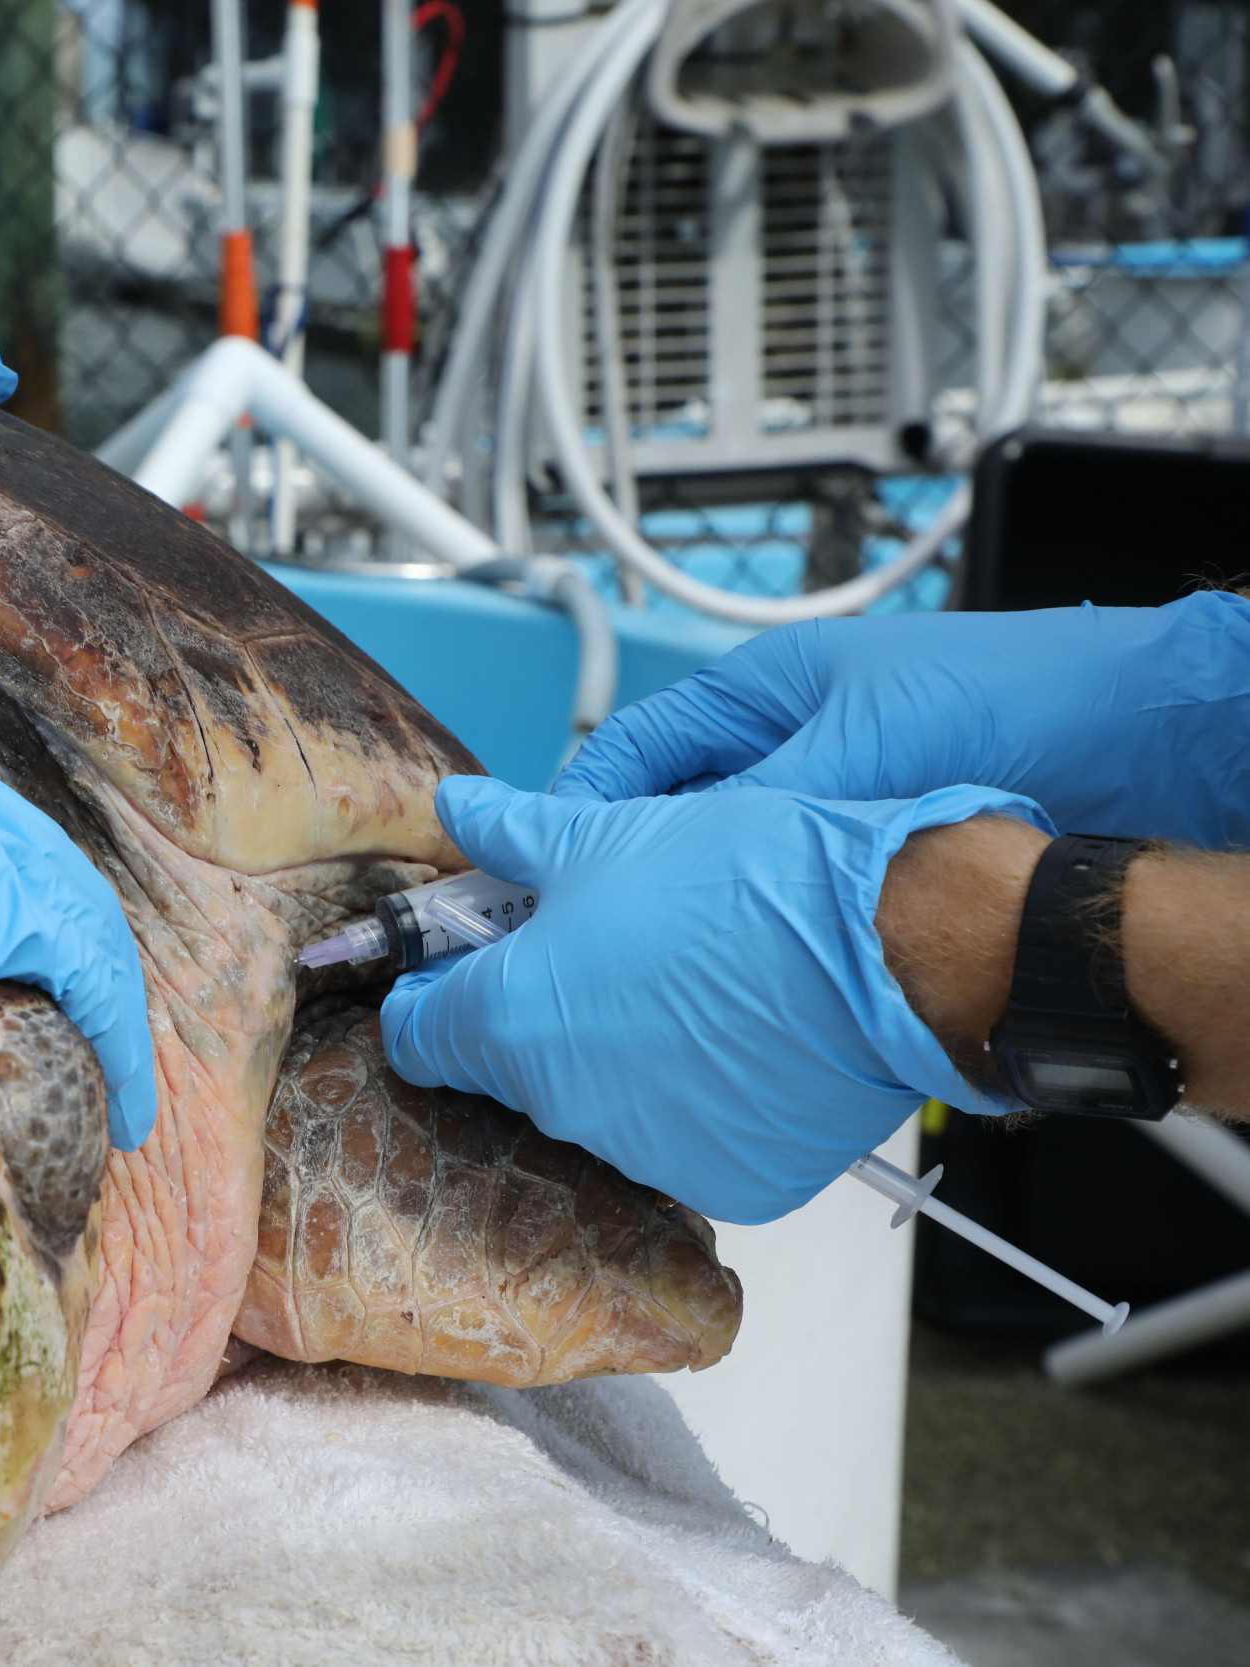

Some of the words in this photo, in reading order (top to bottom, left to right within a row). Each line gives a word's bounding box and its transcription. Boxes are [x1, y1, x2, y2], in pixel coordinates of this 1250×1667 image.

[502, 901, 514, 915] 5
[523, 895, 535, 908] 6
[481, 907, 493, 919] 4
